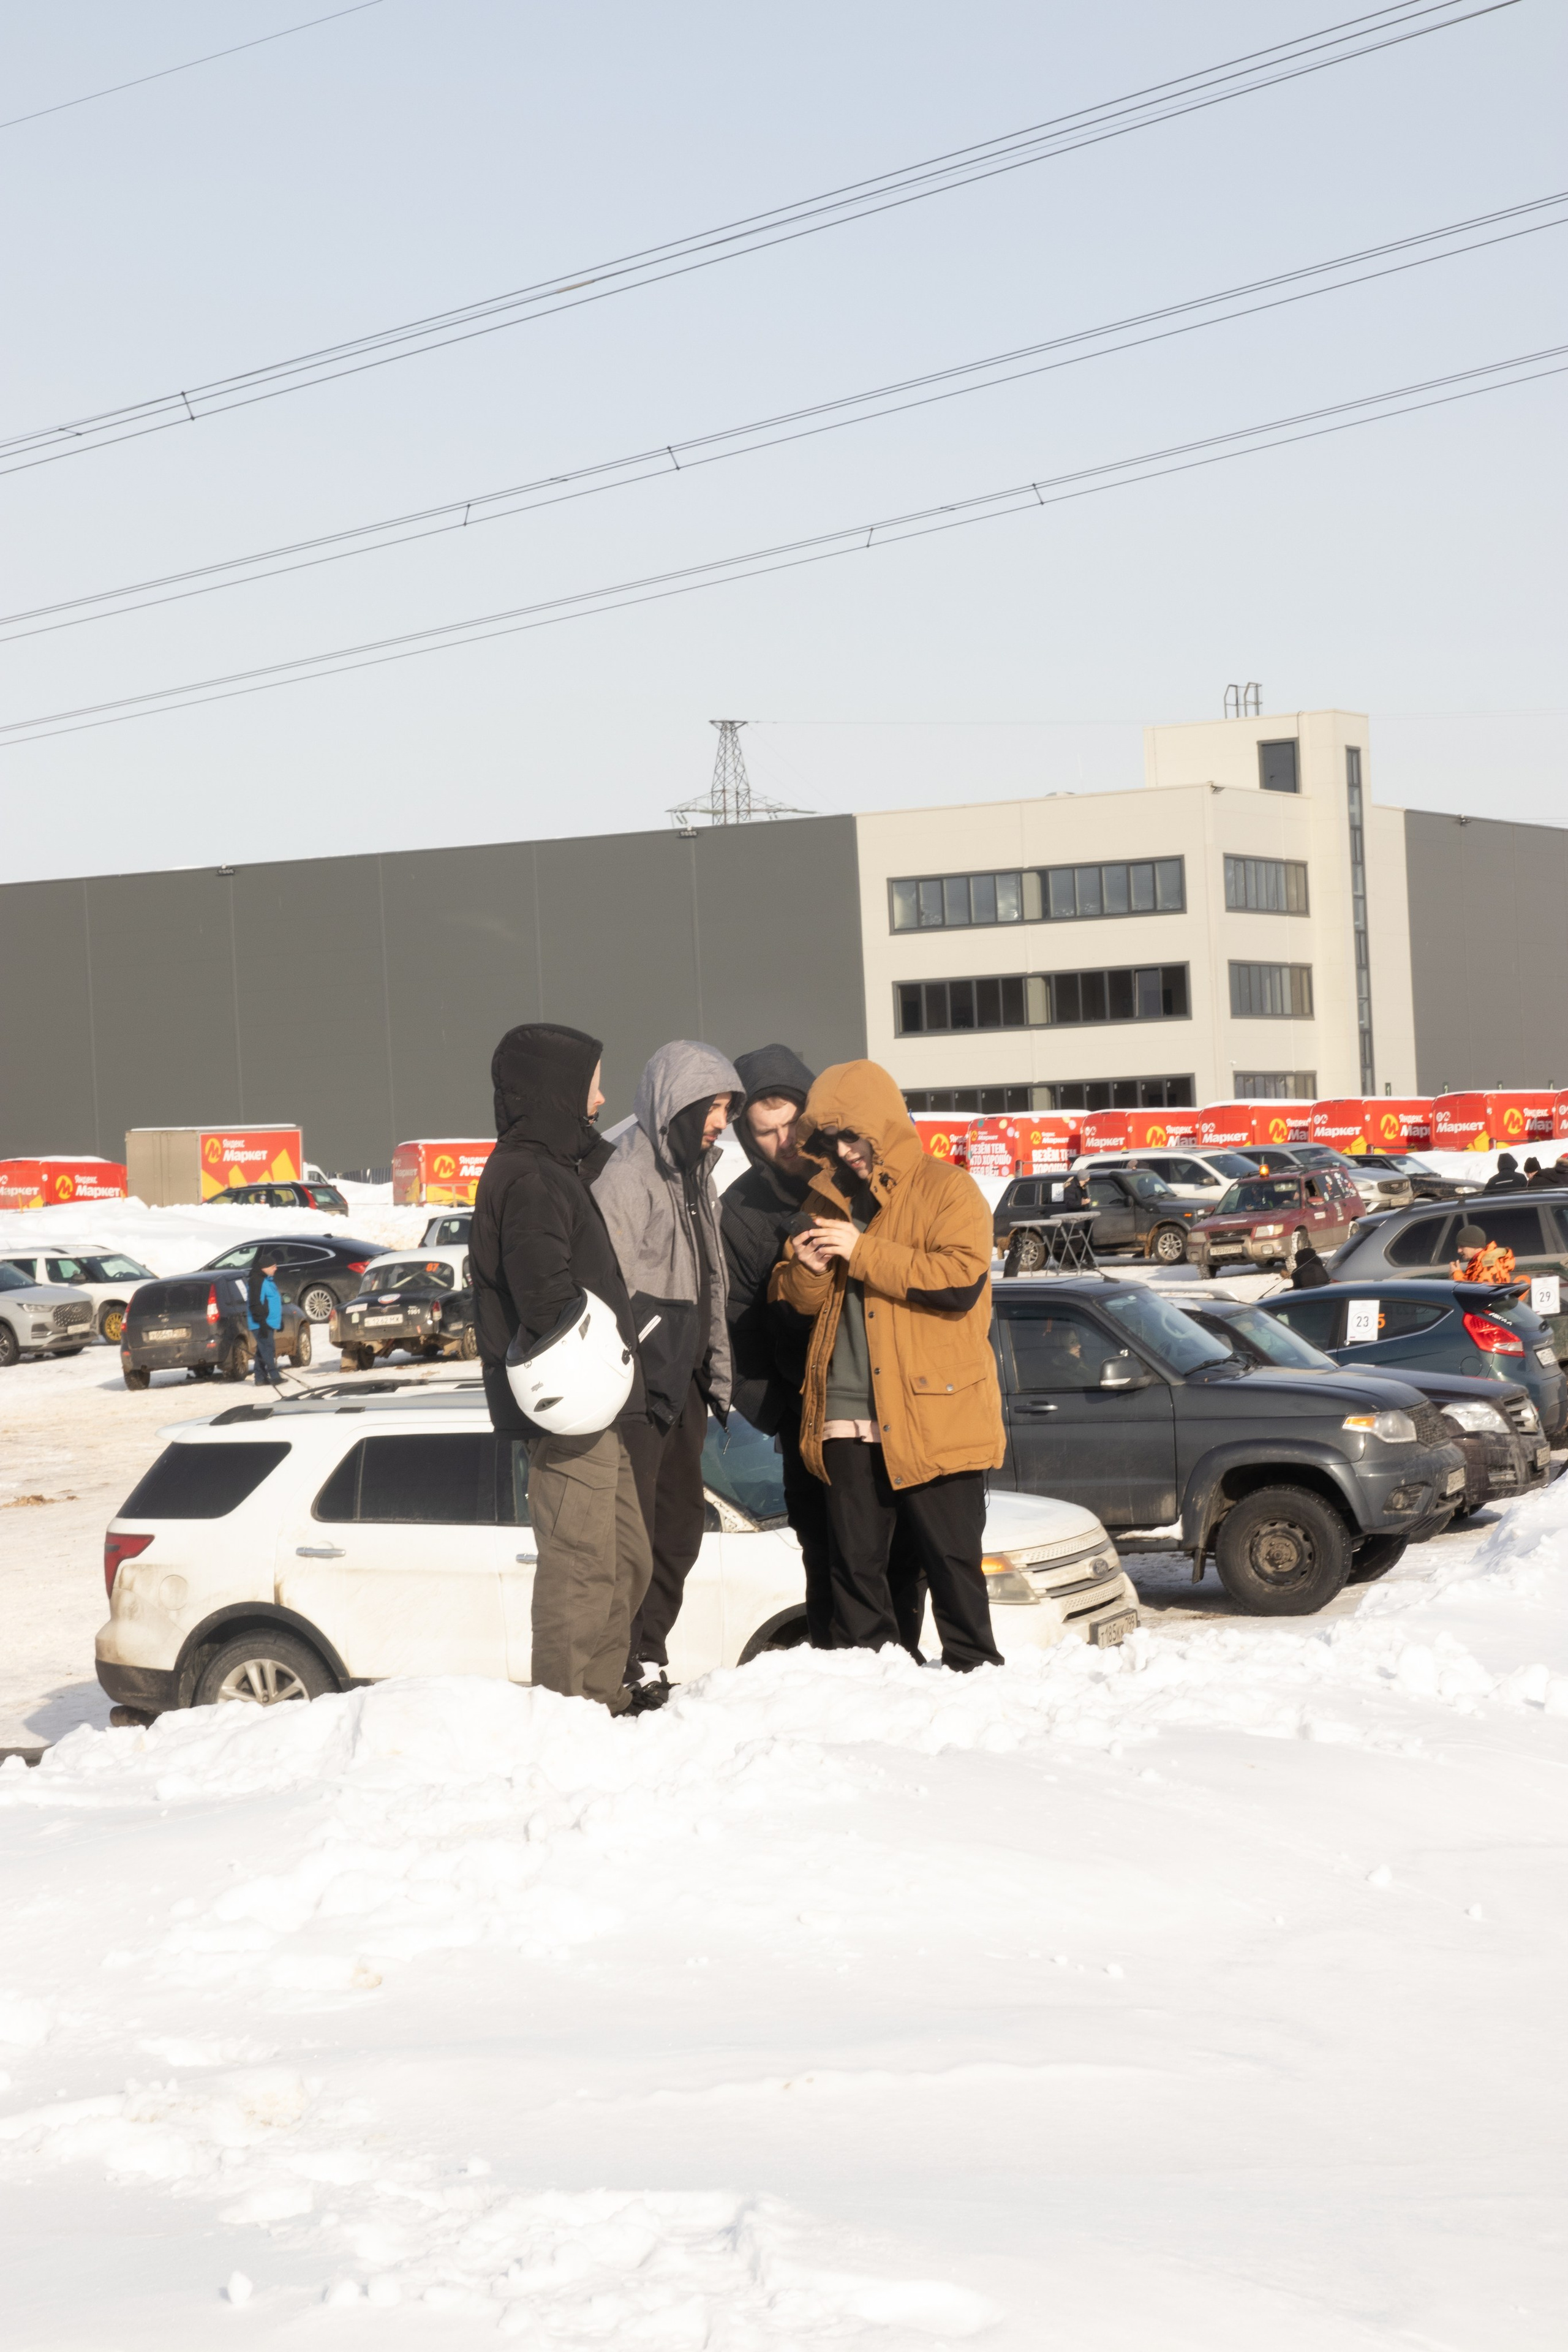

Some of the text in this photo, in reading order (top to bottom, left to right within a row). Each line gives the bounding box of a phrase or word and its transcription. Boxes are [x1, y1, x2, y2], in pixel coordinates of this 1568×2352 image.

[1399, 1114, 1423, 1123] Яндекс
[1523, 1108, 1548, 1118] Яндекс
[1166, 1125, 1193, 1135] Яндекс
[1314, 1126, 1362, 1137] Маркет
[1436, 1121, 1485, 1133] Маркет
[1202, 1133, 1248, 1144] Маркет
[1287, 1129, 1308, 1140] Ма
[222, 1139, 245, 1149] Яндекс
[1085, 1137, 1125, 1148] Маркет
[222, 1150, 268, 1163] Маркет
[982, 1154, 1012, 1166] ХОРОШО
[1032, 1147, 1060, 1163] ВЕЗЁМ
[75, 1175, 98, 1184] Яндекс
[75, 1185, 121, 1198] Маркет
[1539, 1291, 1551, 1303] 29
[1356, 1316, 1369, 1327] 23
